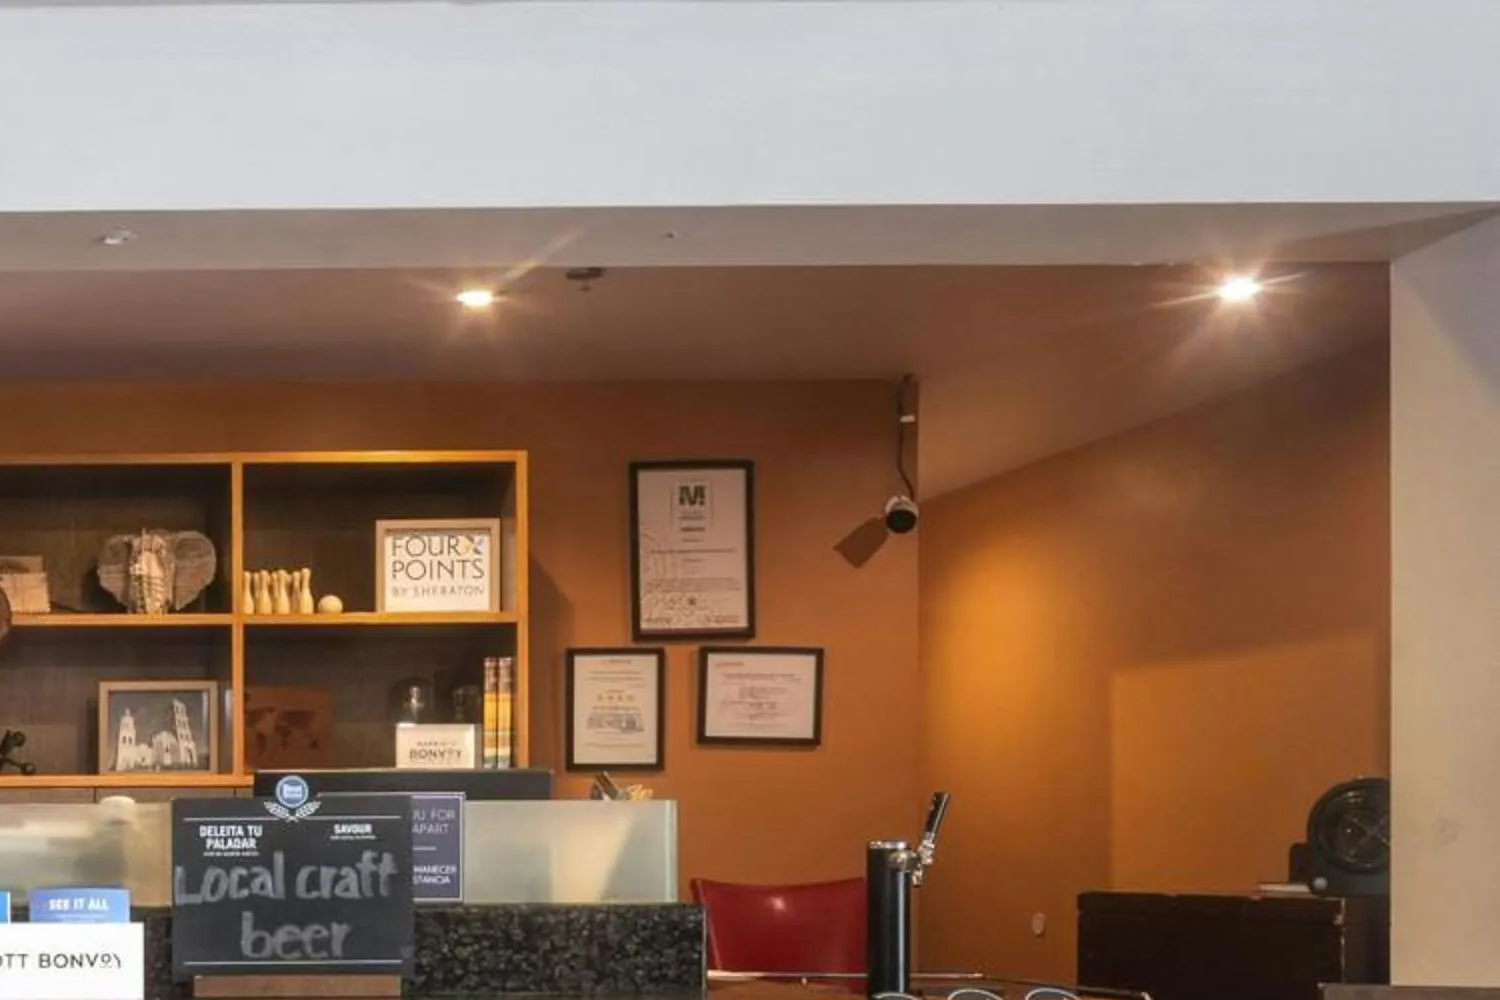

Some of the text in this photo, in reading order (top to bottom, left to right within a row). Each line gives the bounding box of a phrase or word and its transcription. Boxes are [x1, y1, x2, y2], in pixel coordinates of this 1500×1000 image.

[391, 534, 461, 557] FOUR
[391, 559, 485, 580] POINTS
[414, 585, 484, 598] SHERATON
[199, 824, 263, 837] DELEITA TU
[205, 838, 257, 849] PALADAR
[295, 850, 399, 899] craft
[73, 898, 85, 910] IT
[88, 897, 110, 911] ALL
[240, 911, 352, 960] beer
